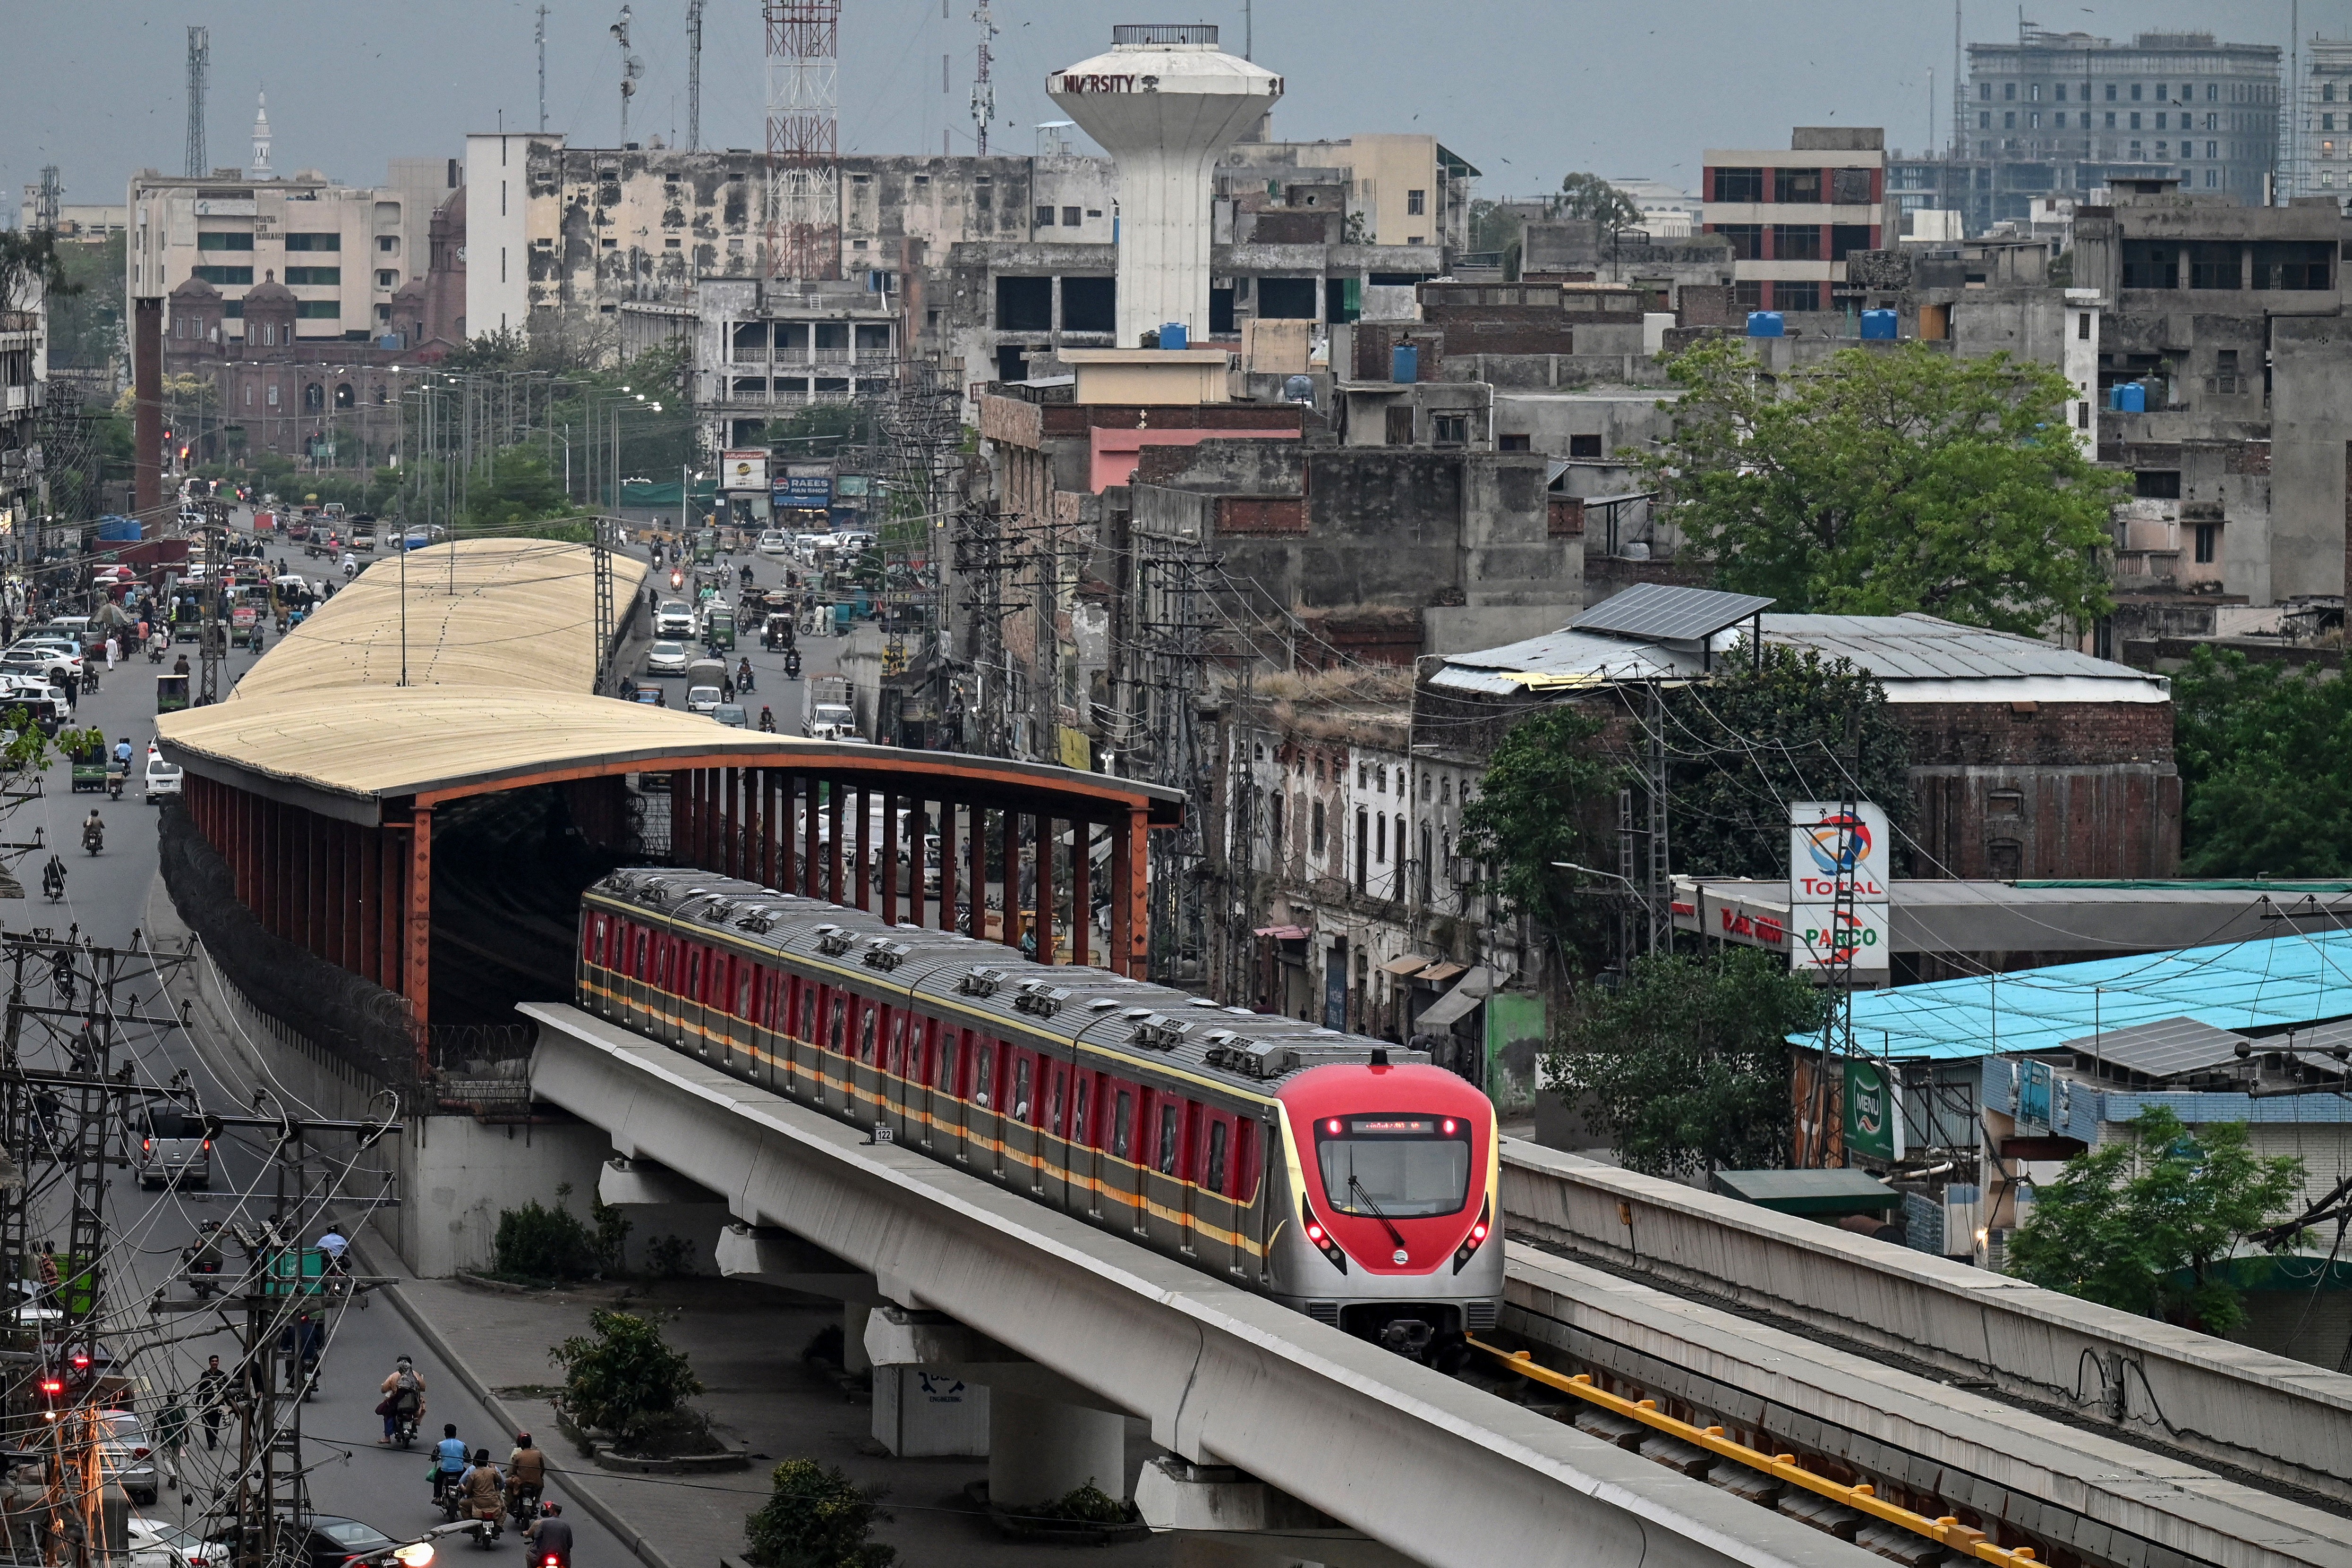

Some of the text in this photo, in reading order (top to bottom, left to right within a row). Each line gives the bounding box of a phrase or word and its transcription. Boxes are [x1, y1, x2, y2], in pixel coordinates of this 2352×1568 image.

[791, 479, 828, 487] RAEES
[1800, 878, 1882, 895] TOTAL
[1857, 1093, 1879, 1116] MENU
[878, 1130, 891, 1140] 122
